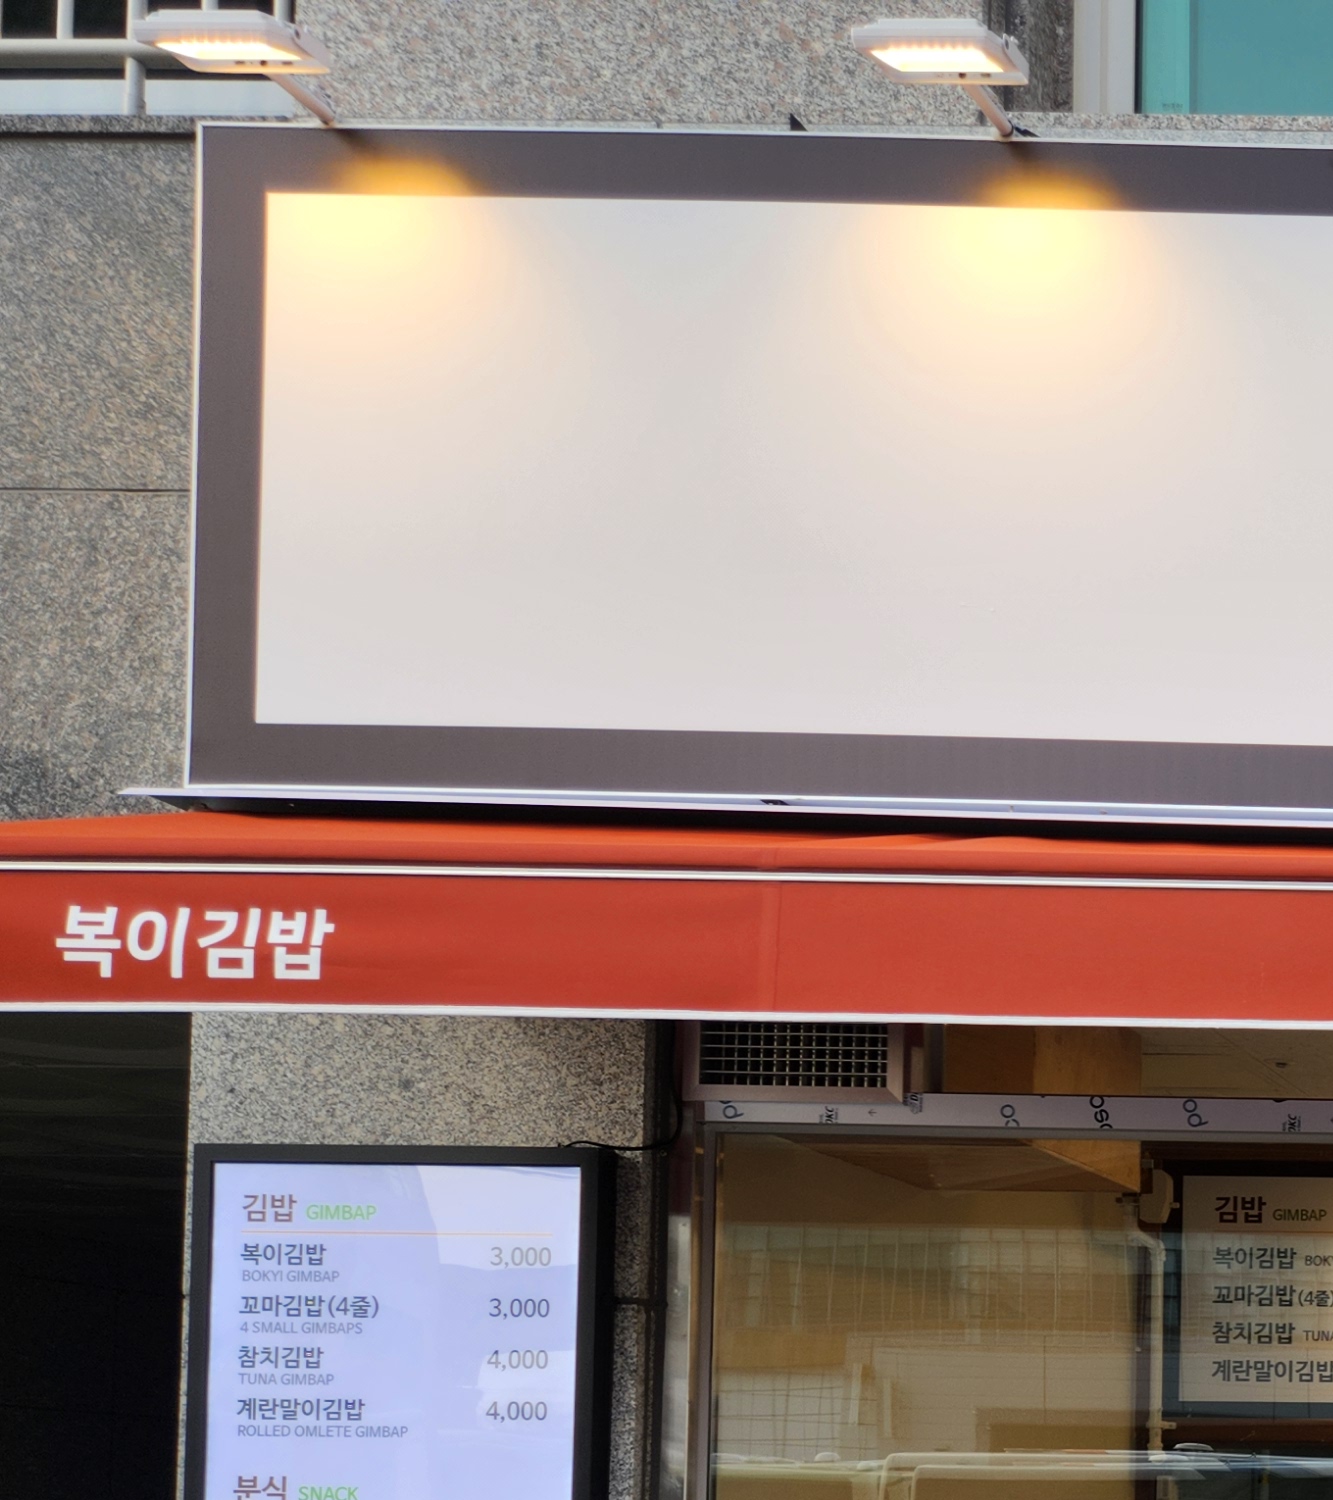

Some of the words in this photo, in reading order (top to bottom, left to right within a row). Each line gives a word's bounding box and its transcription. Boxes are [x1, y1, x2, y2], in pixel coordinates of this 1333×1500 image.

[56, 905, 335, 980] 복이김밥
[242, 1194, 297, 1223] 김밥
[306, 1204, 377, 1222] GIMBAP
[1214, 1196, 1266, 1224] 김밥
[1273, 1208, 1327, 1222] GIMBAP
[240, 1242, 326, 1266] 복이김밥
[489, 1246, 552, 1269] 3,000
[1212, 1246, 1297, 1270] 복이김밥
[242, 1270, 285, 1283] BOKYI
[287, 1271, 340, 1283] GIMBAP
[239, 1294, 380, 1320] 꼬마김밥(4줄)
[488, 1298, 550, 1320] 3,000
[252, 1322, 298, 1334] SMALL
[301, 1322, 363, 1334] GIMBAPS
[1212, 1322, 1295, 1345] 참치김밥
[238, 1346, 323, 1369] 참치김밥
[487, 1349, 549, 1372] 4,000
[238, 1373, 277, 1385] TUNA
[280, 1373, 334, 1386] GIMBAP
[236, 1398, 365, 1421] 계란말이김밥
[485, 1401, 548, 1423] 4,000
[237, 1425, 291, 1437] ROLLED
[294, 1425, 352, 1437] OMLETE
[354, 1425, 408, 1438] GIMBAP
